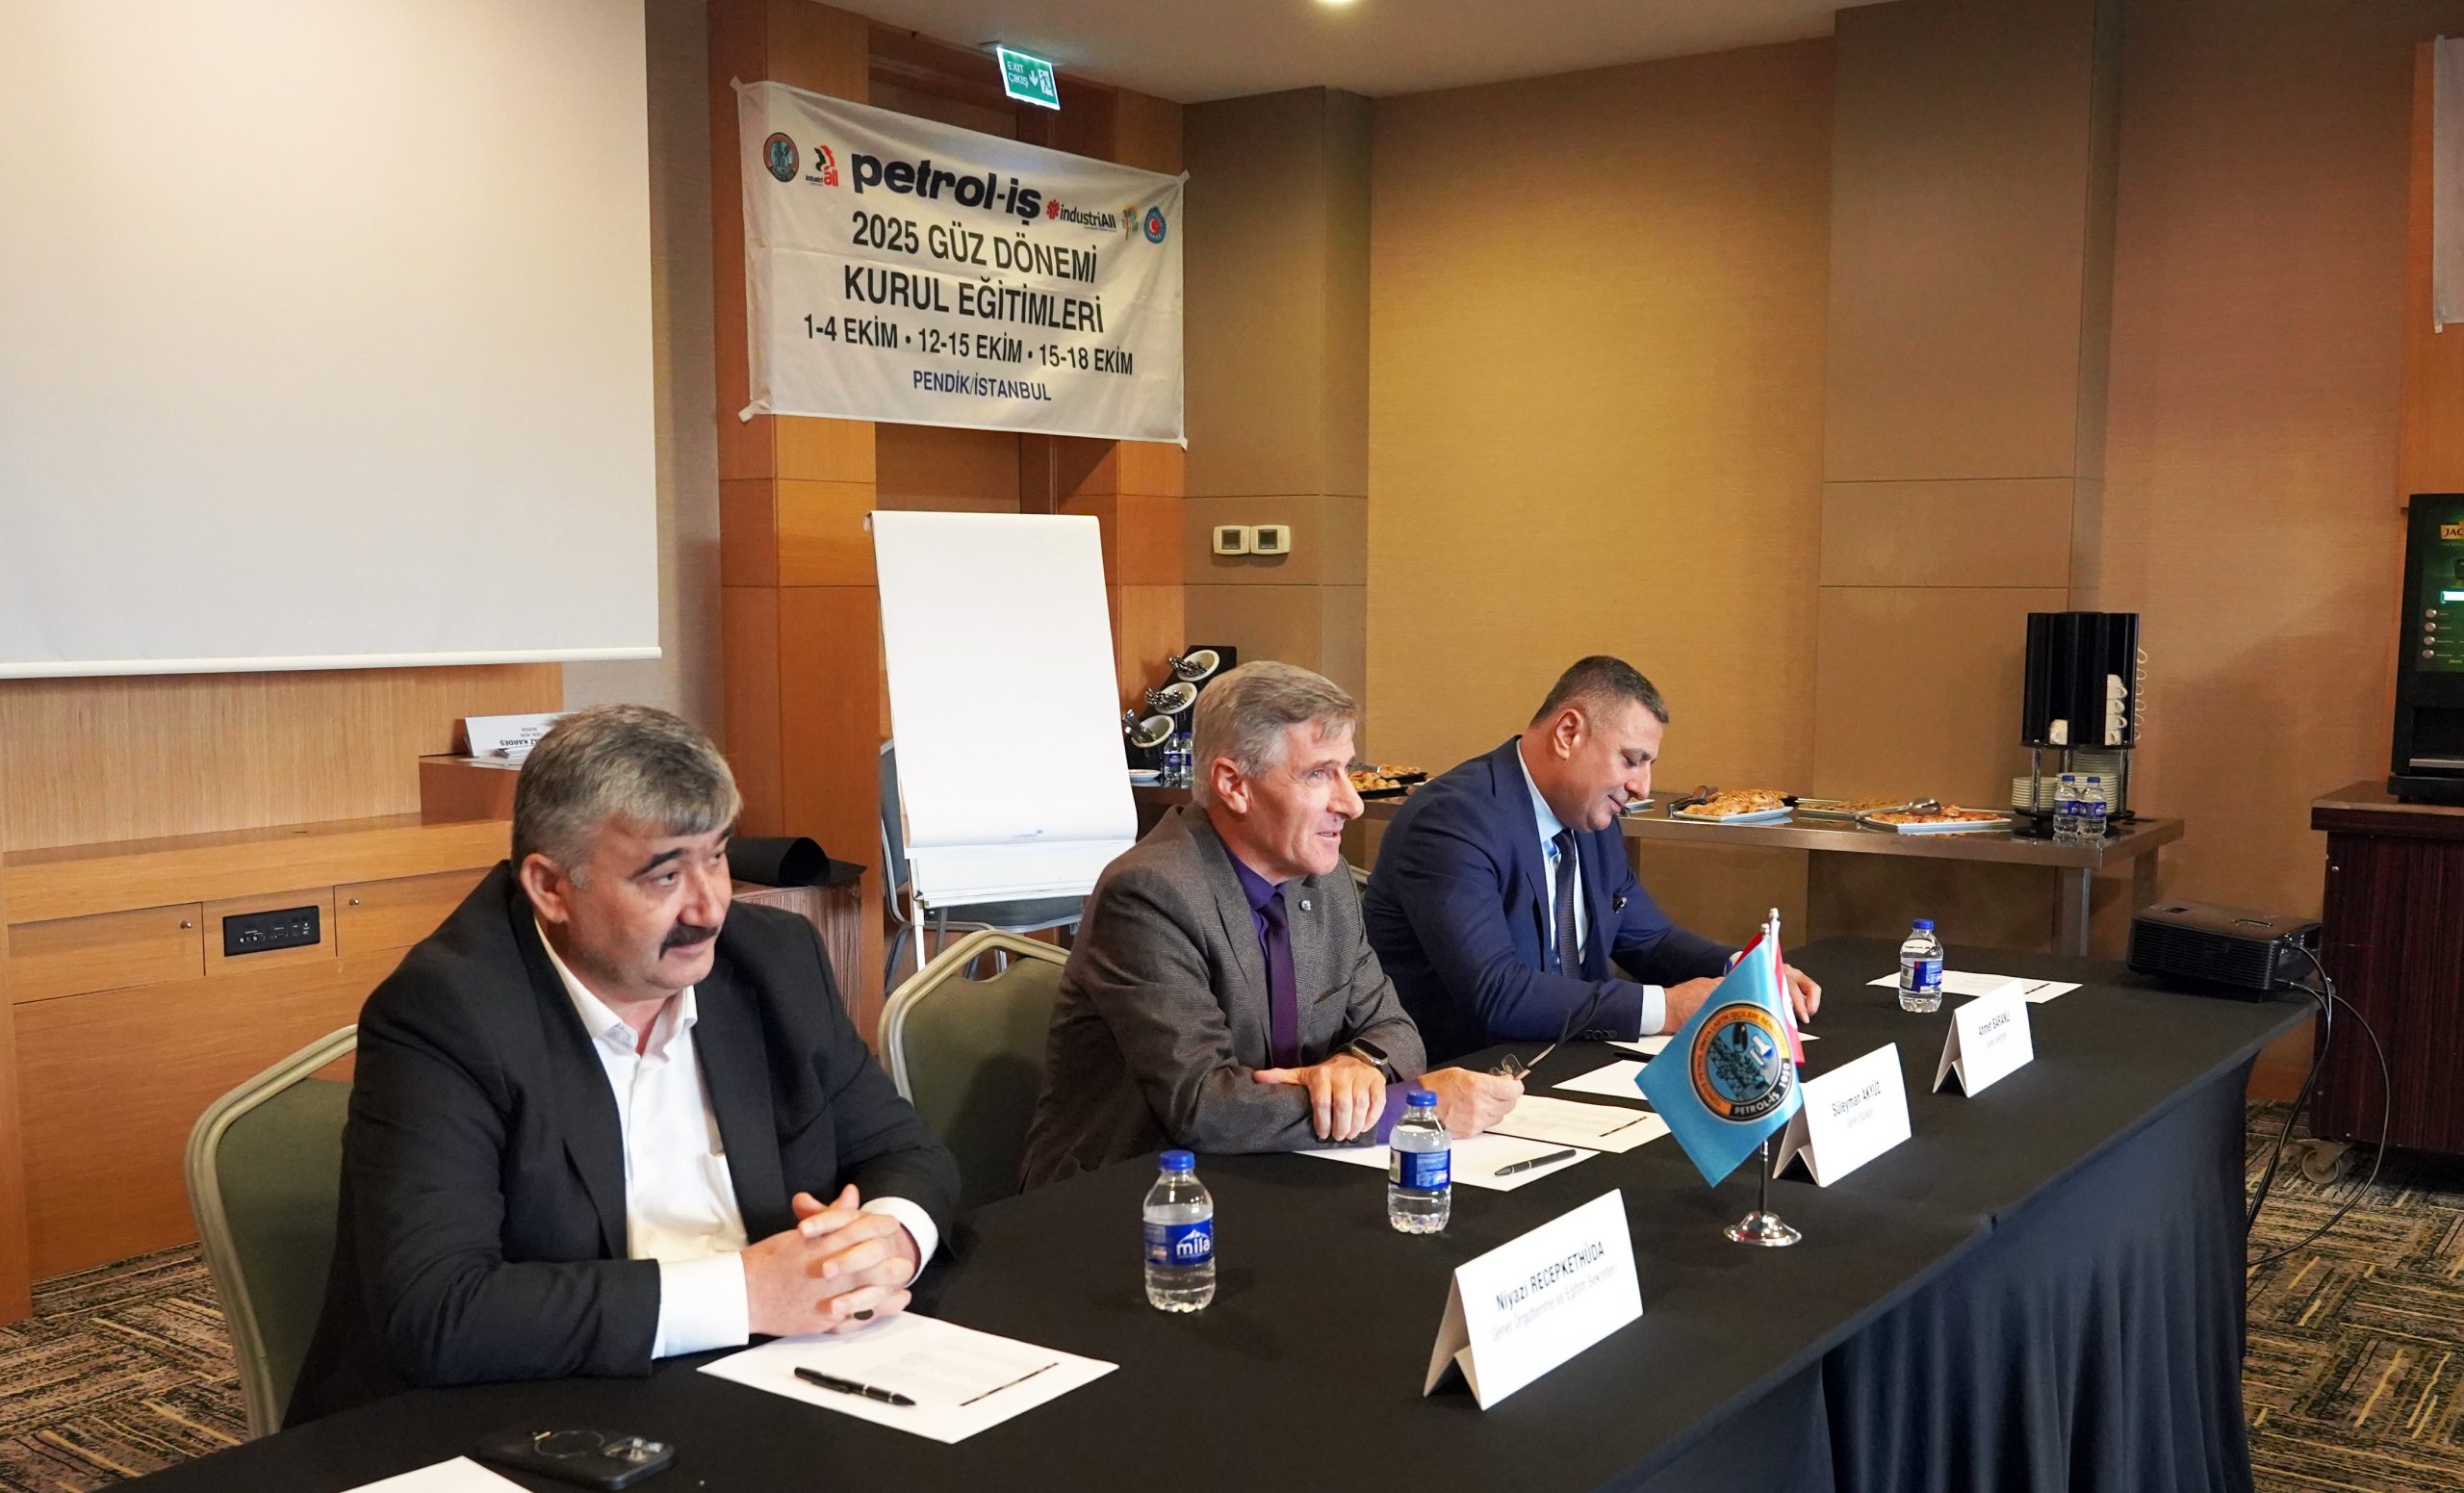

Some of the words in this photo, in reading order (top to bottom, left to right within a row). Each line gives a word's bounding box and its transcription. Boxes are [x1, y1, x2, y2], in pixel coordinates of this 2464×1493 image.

[1007, 61, 1024, 73] EXIT
[851, 153, 1041, 225] petrol-iş
[1060, 204, 1116, 229] industriAll
[852, 211, 919, 254] 2025
[928, 220, 987, 266] GÜZ
[994, 232, 1097, 283] DÖNEMİ
[844, 265, 949, 313] KURUL
[959, 275, 1104, 333] EĞİTİMLERİ
[804, 313, 837, 342] 1-4
[844, 315, 898, 348] EKİM
[918, 328, 970, 357] 12-15
[977, 332, 1022, 363] EKİM
[1040, 344, 1089, 370] 15-18
[1094, 346, 1133, 375] EKİM
[913, 370, 1052, 401] PENDİK/İSTANBUL
[1176, 1238, 1211, 1256] mila
[1496, 1279, 1528, 1311] Niyazi
[1530, 1241, 1604, 1293] RECEPKETHÜDA
